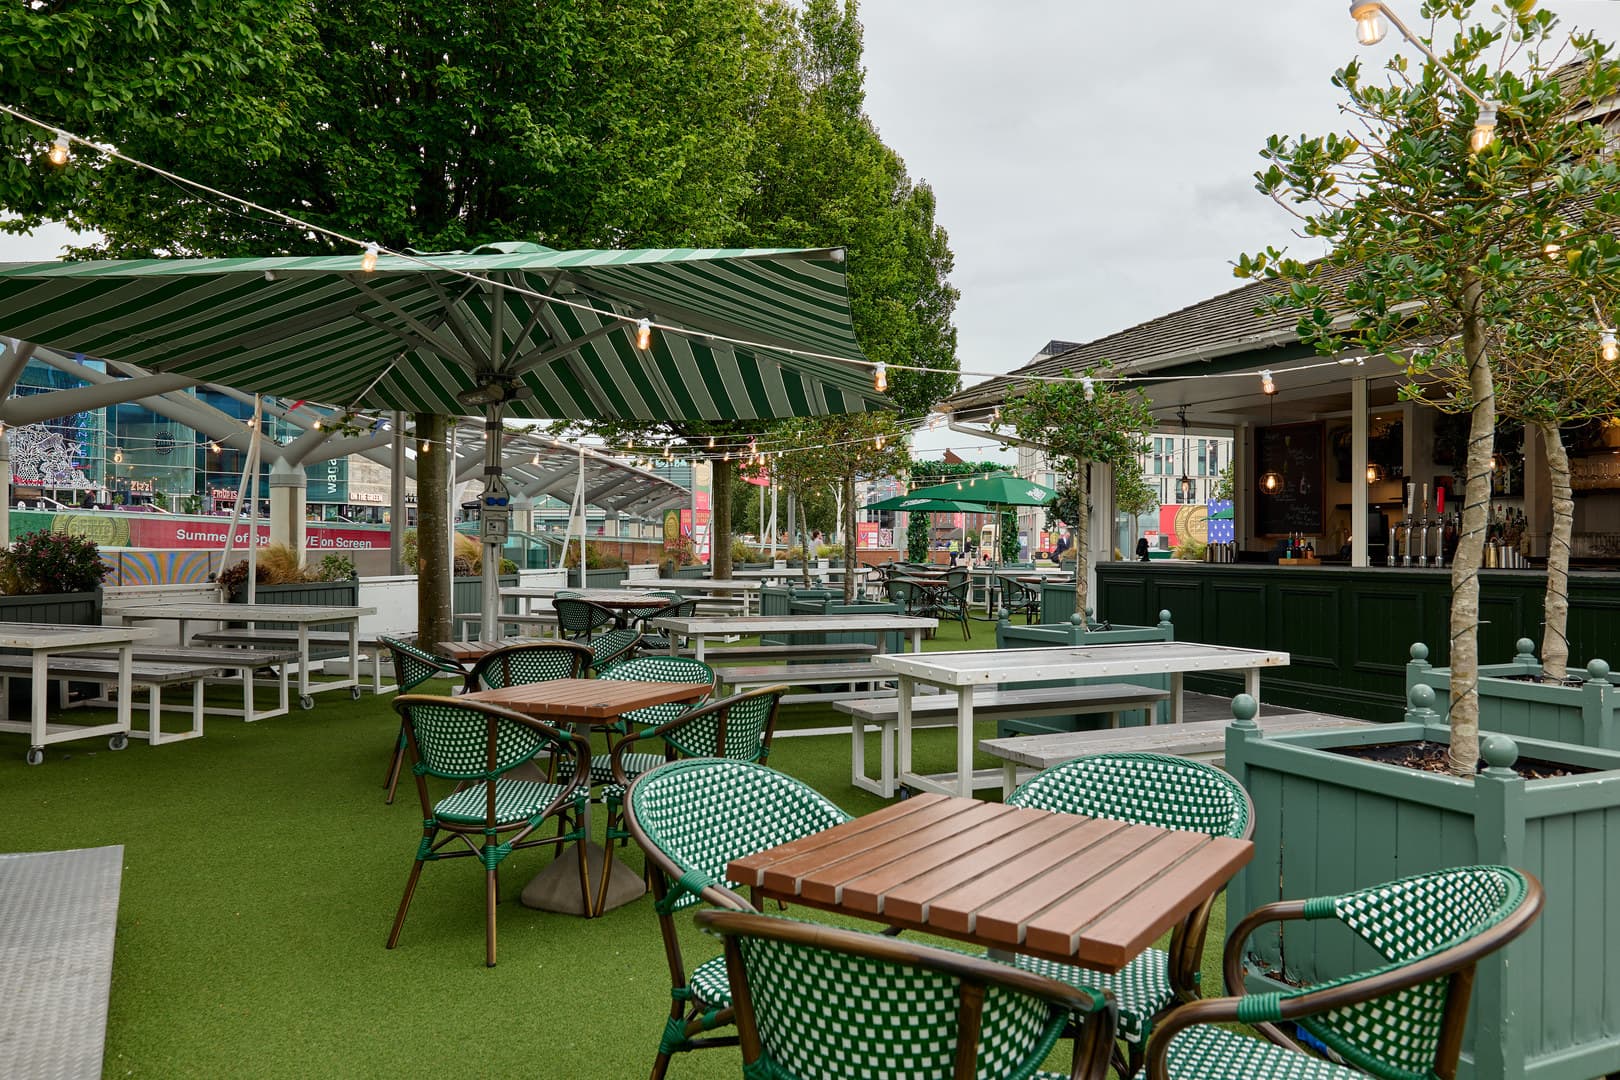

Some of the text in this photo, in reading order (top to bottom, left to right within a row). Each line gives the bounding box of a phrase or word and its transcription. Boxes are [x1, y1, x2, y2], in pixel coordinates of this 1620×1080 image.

[328, 458, 339, 494] waga
[358, 492, 367, 501] THE
[176, 529, 227, 542] Summe
[235, 533, 249, 543] of
[321, 538, 334, 547] on
[336, 537, 372, 548] Screen
